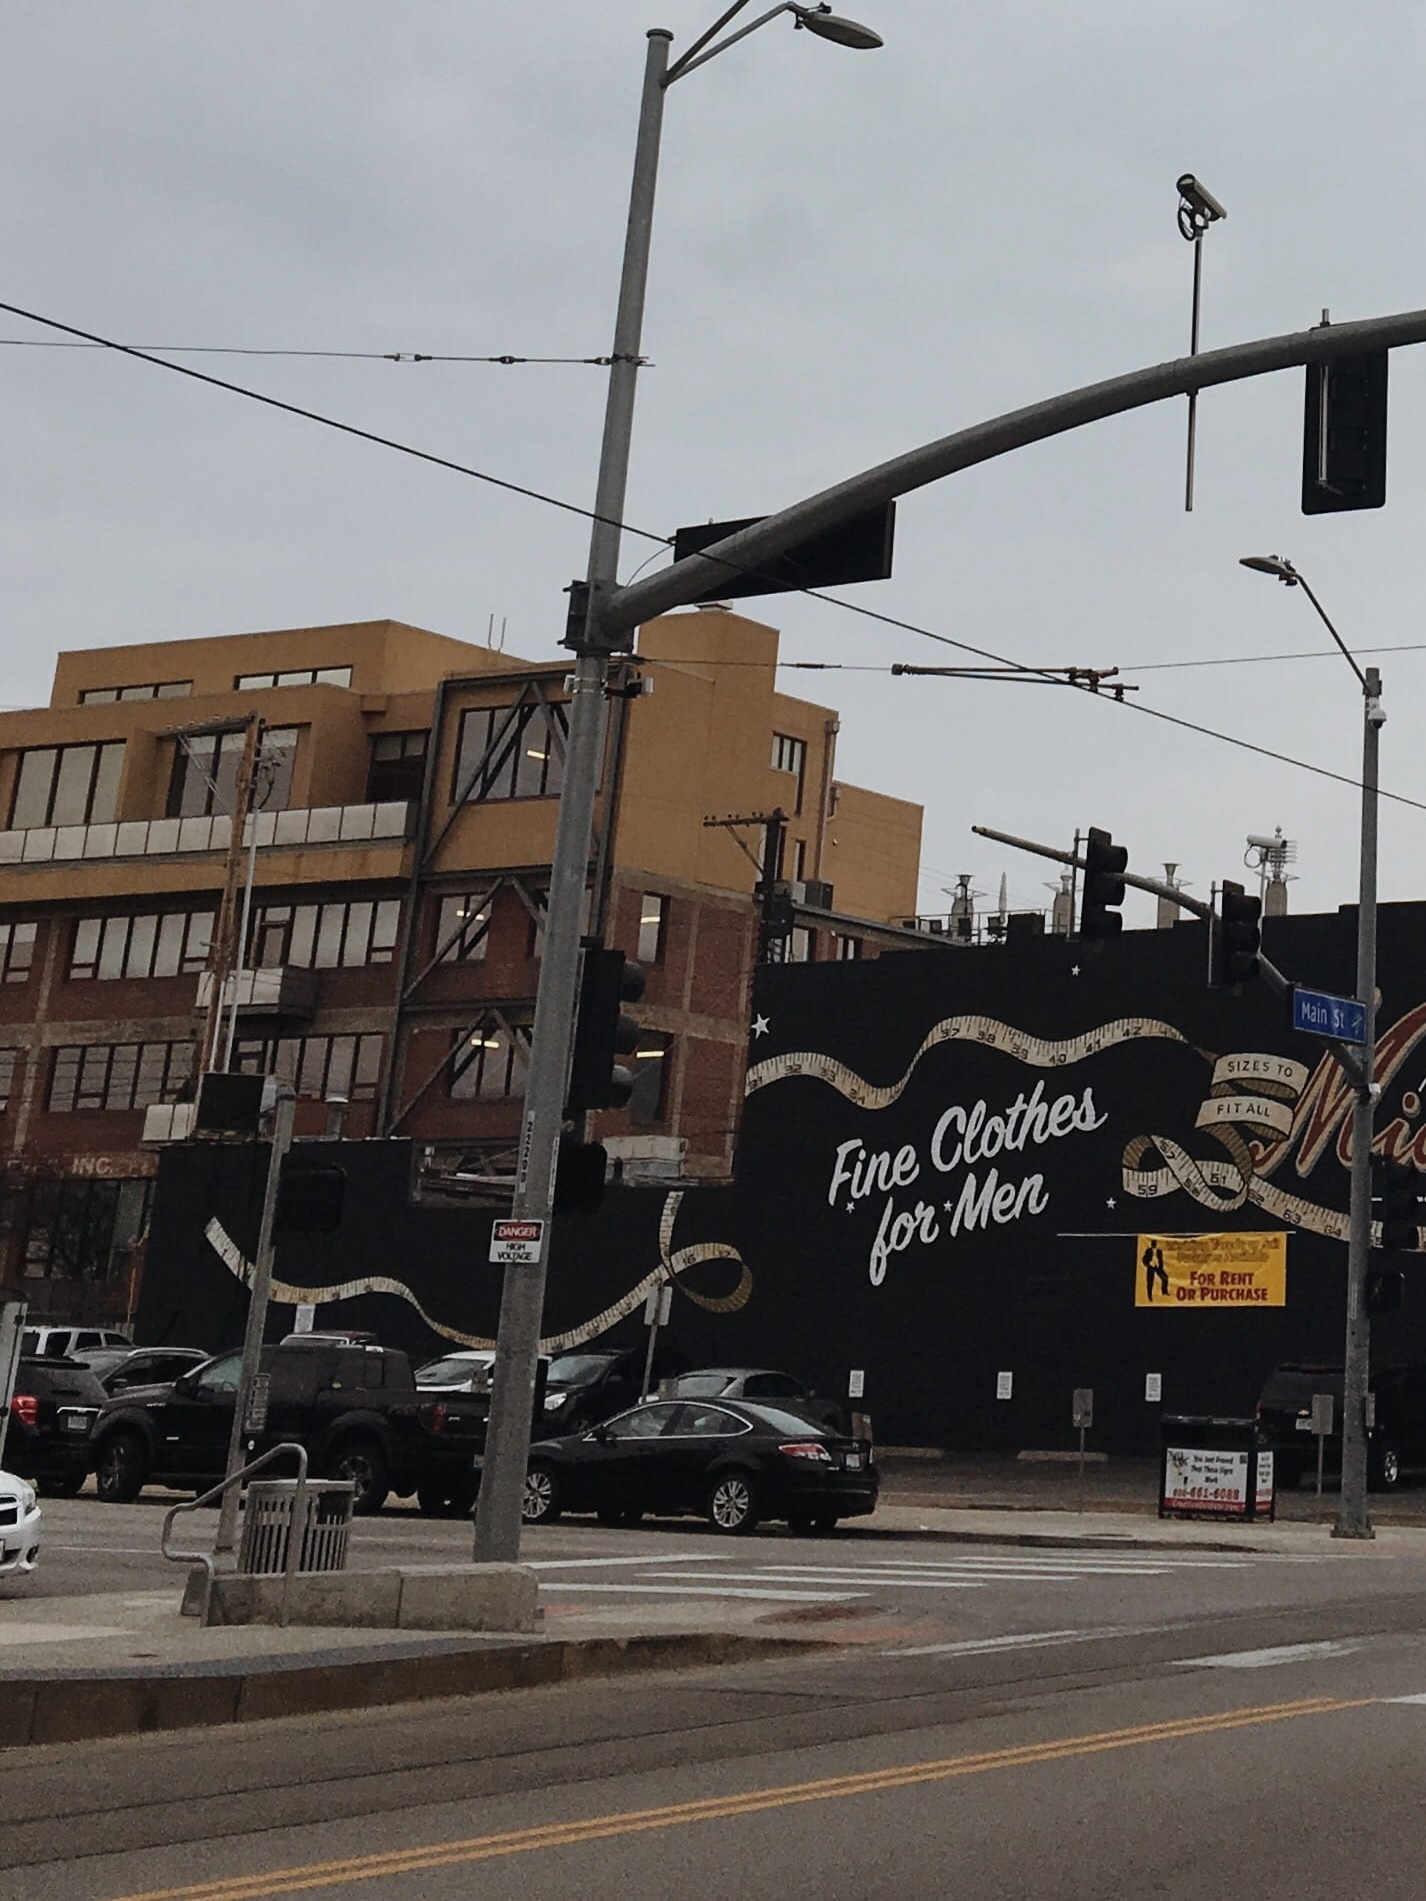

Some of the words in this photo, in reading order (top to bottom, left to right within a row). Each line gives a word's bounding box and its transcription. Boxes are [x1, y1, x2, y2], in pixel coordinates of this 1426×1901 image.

[1301, 1001, 1328, 1025] Main
[1333, 1008, 1345, 1029] St
[1227, 1061, 1270, 1073] SIZES
[1277, 1064, 1293, 1077] TO
[1216, 1103, 1242, 1115] FIT
[1245, 1103, 1271, 1117] ALL
[829, 1138, 920, 1206] Fine
[931, 1079, 1108, 1172] Clothes
[498, 1225, 537, 1238] DANGER
[869, 1196, 940, 1286] for
[950, 1167, 1050, 1237] Men
[505, 1242, 526, 1251] HIGH
[497, 1251, 533, 1261] VOLTAGE
[1190, 1270, 1216, 1286] FOR
[1220, 1270, 1255, 1286] RENT
[1176, 1286, 1197, 1301] OR
[1200, 1286, 1269, 1302] PURCHASE
